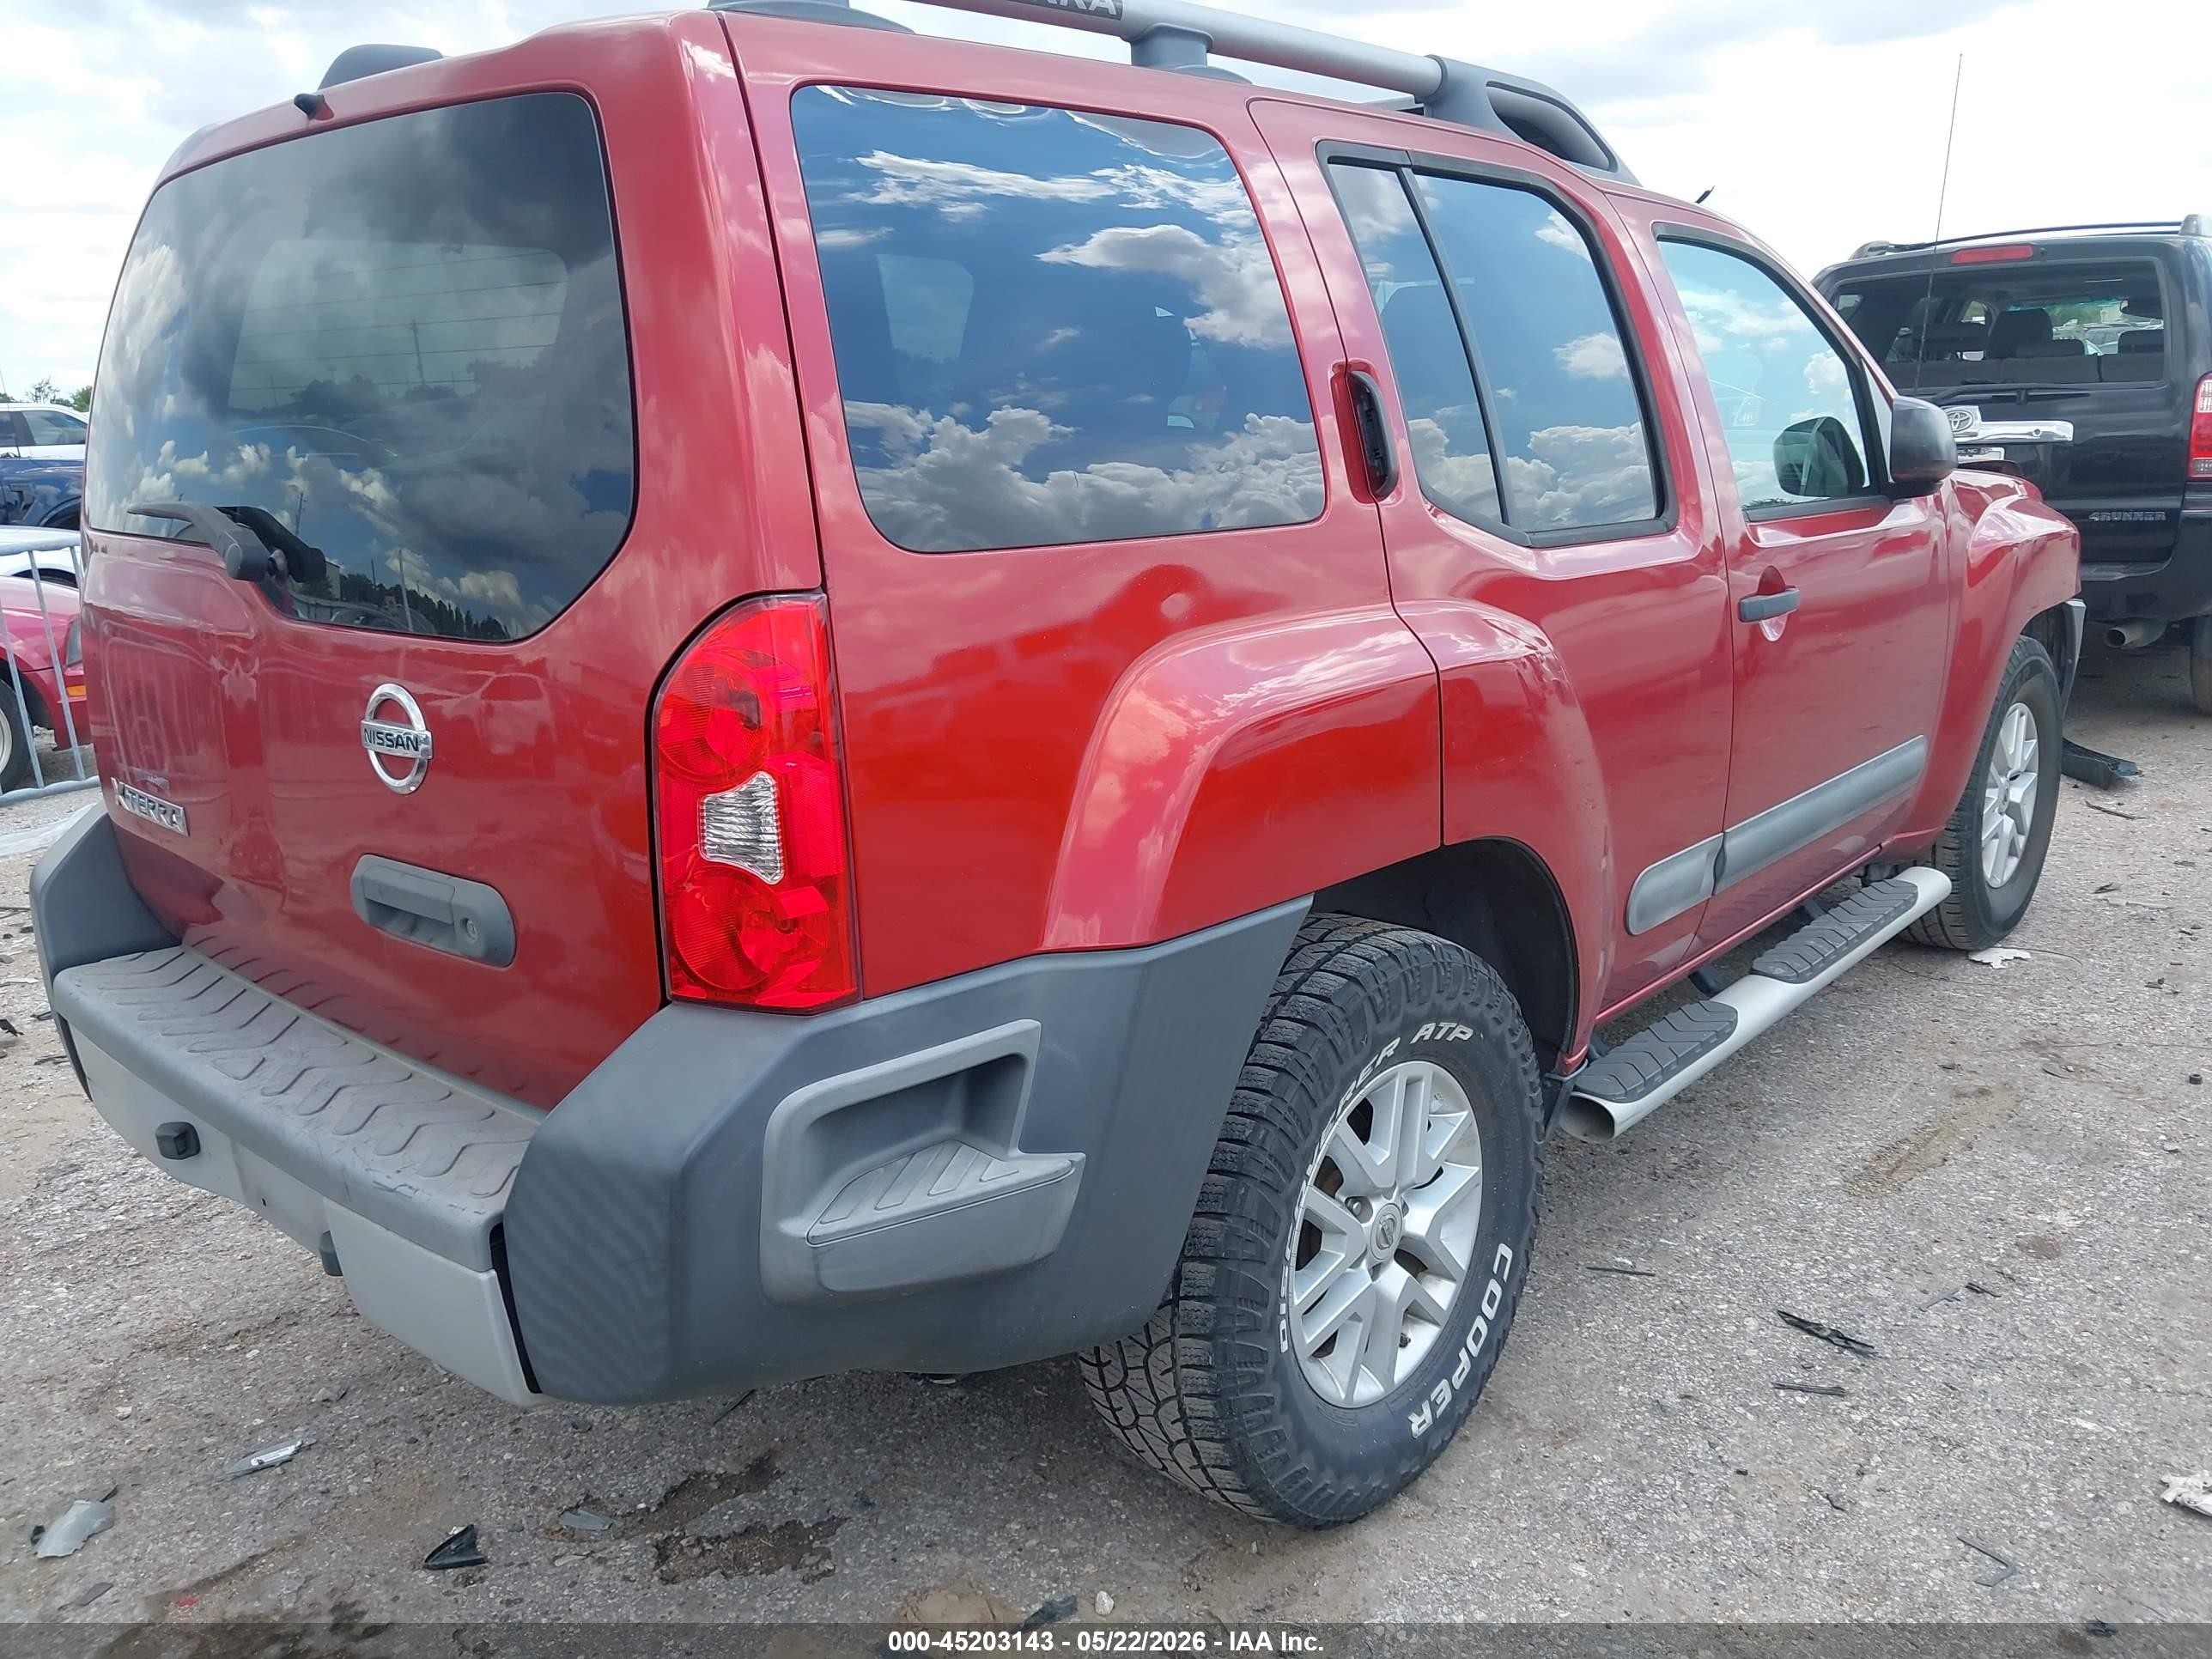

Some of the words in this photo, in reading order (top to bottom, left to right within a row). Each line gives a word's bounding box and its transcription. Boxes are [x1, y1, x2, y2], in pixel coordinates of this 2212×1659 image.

[2088, 511, 2166, 521] 4RUNNER
[363, 727, 420, 752] NISSAN
[111, 776, 186, 834] XTERRA
[1409, 1022, 1474, 1044] ATP
[1407, 1243, 1514, 1439] COOPER
